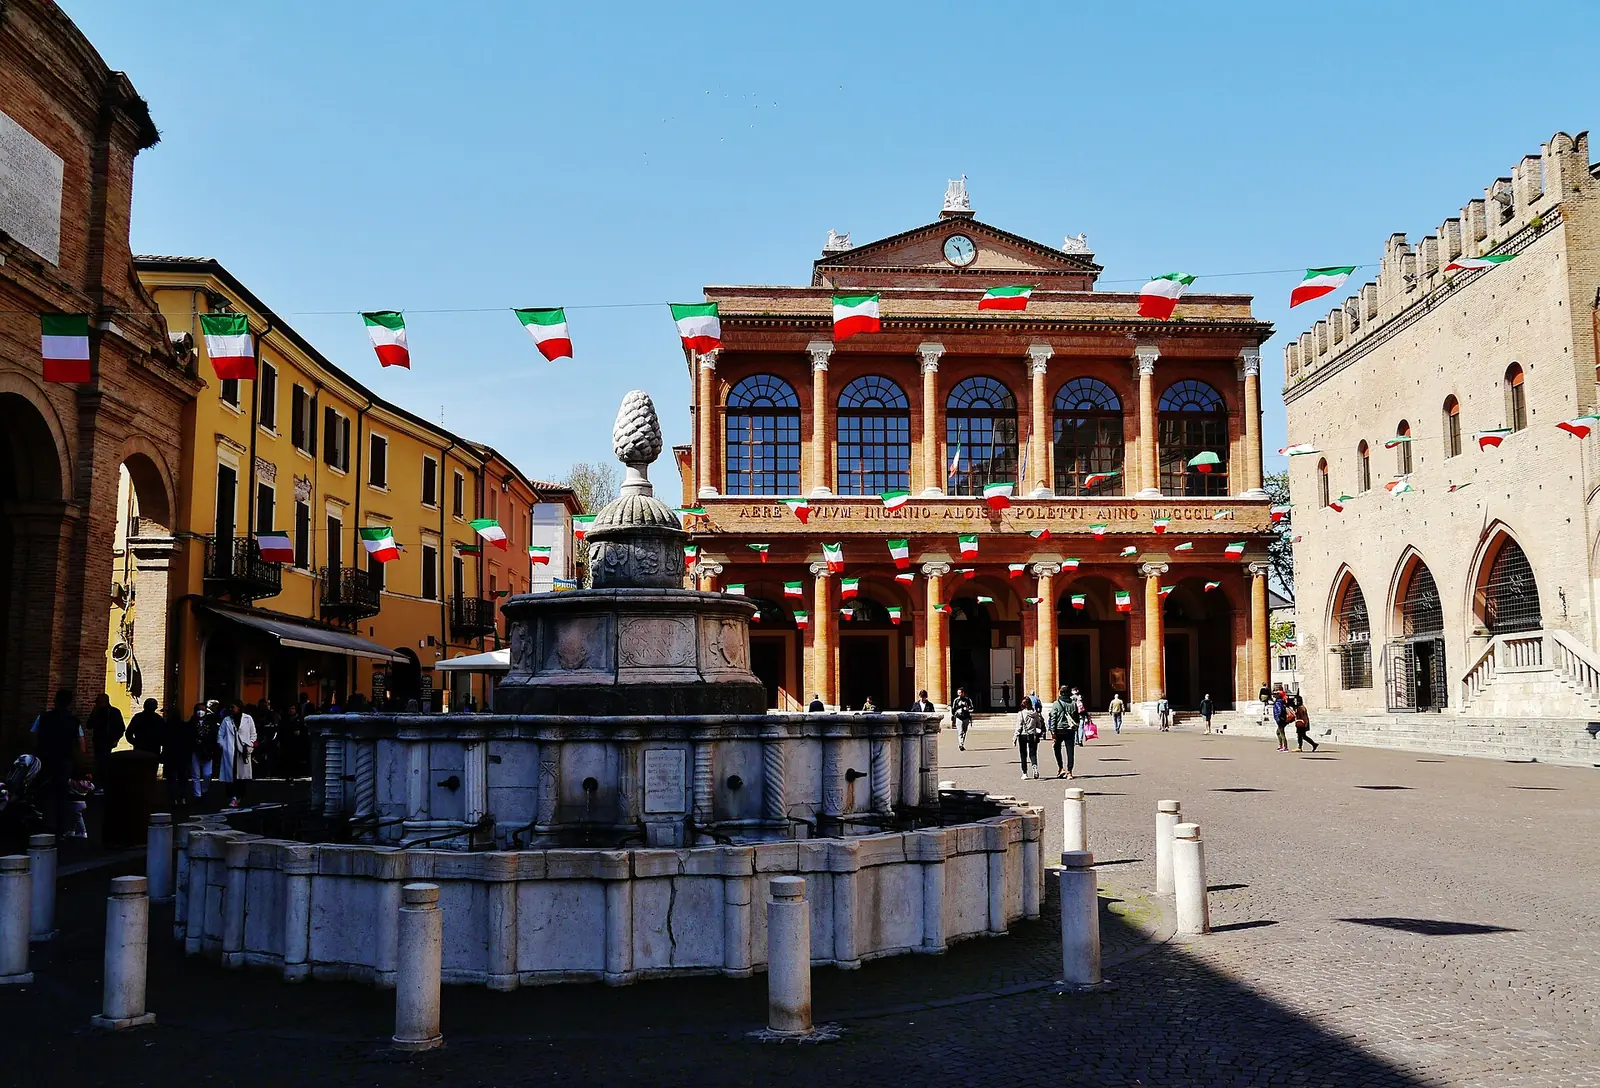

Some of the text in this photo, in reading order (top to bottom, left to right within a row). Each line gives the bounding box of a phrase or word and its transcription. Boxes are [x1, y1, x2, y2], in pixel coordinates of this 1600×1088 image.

[739, 506, 782, 519] AERE
[807, 506, 852, 519] VIVM
[864, 506, 931, 519] INGENIO
[1015, 507, 1084, 520] POLETTI
[1096, 507, 1139, 520] ANNO
